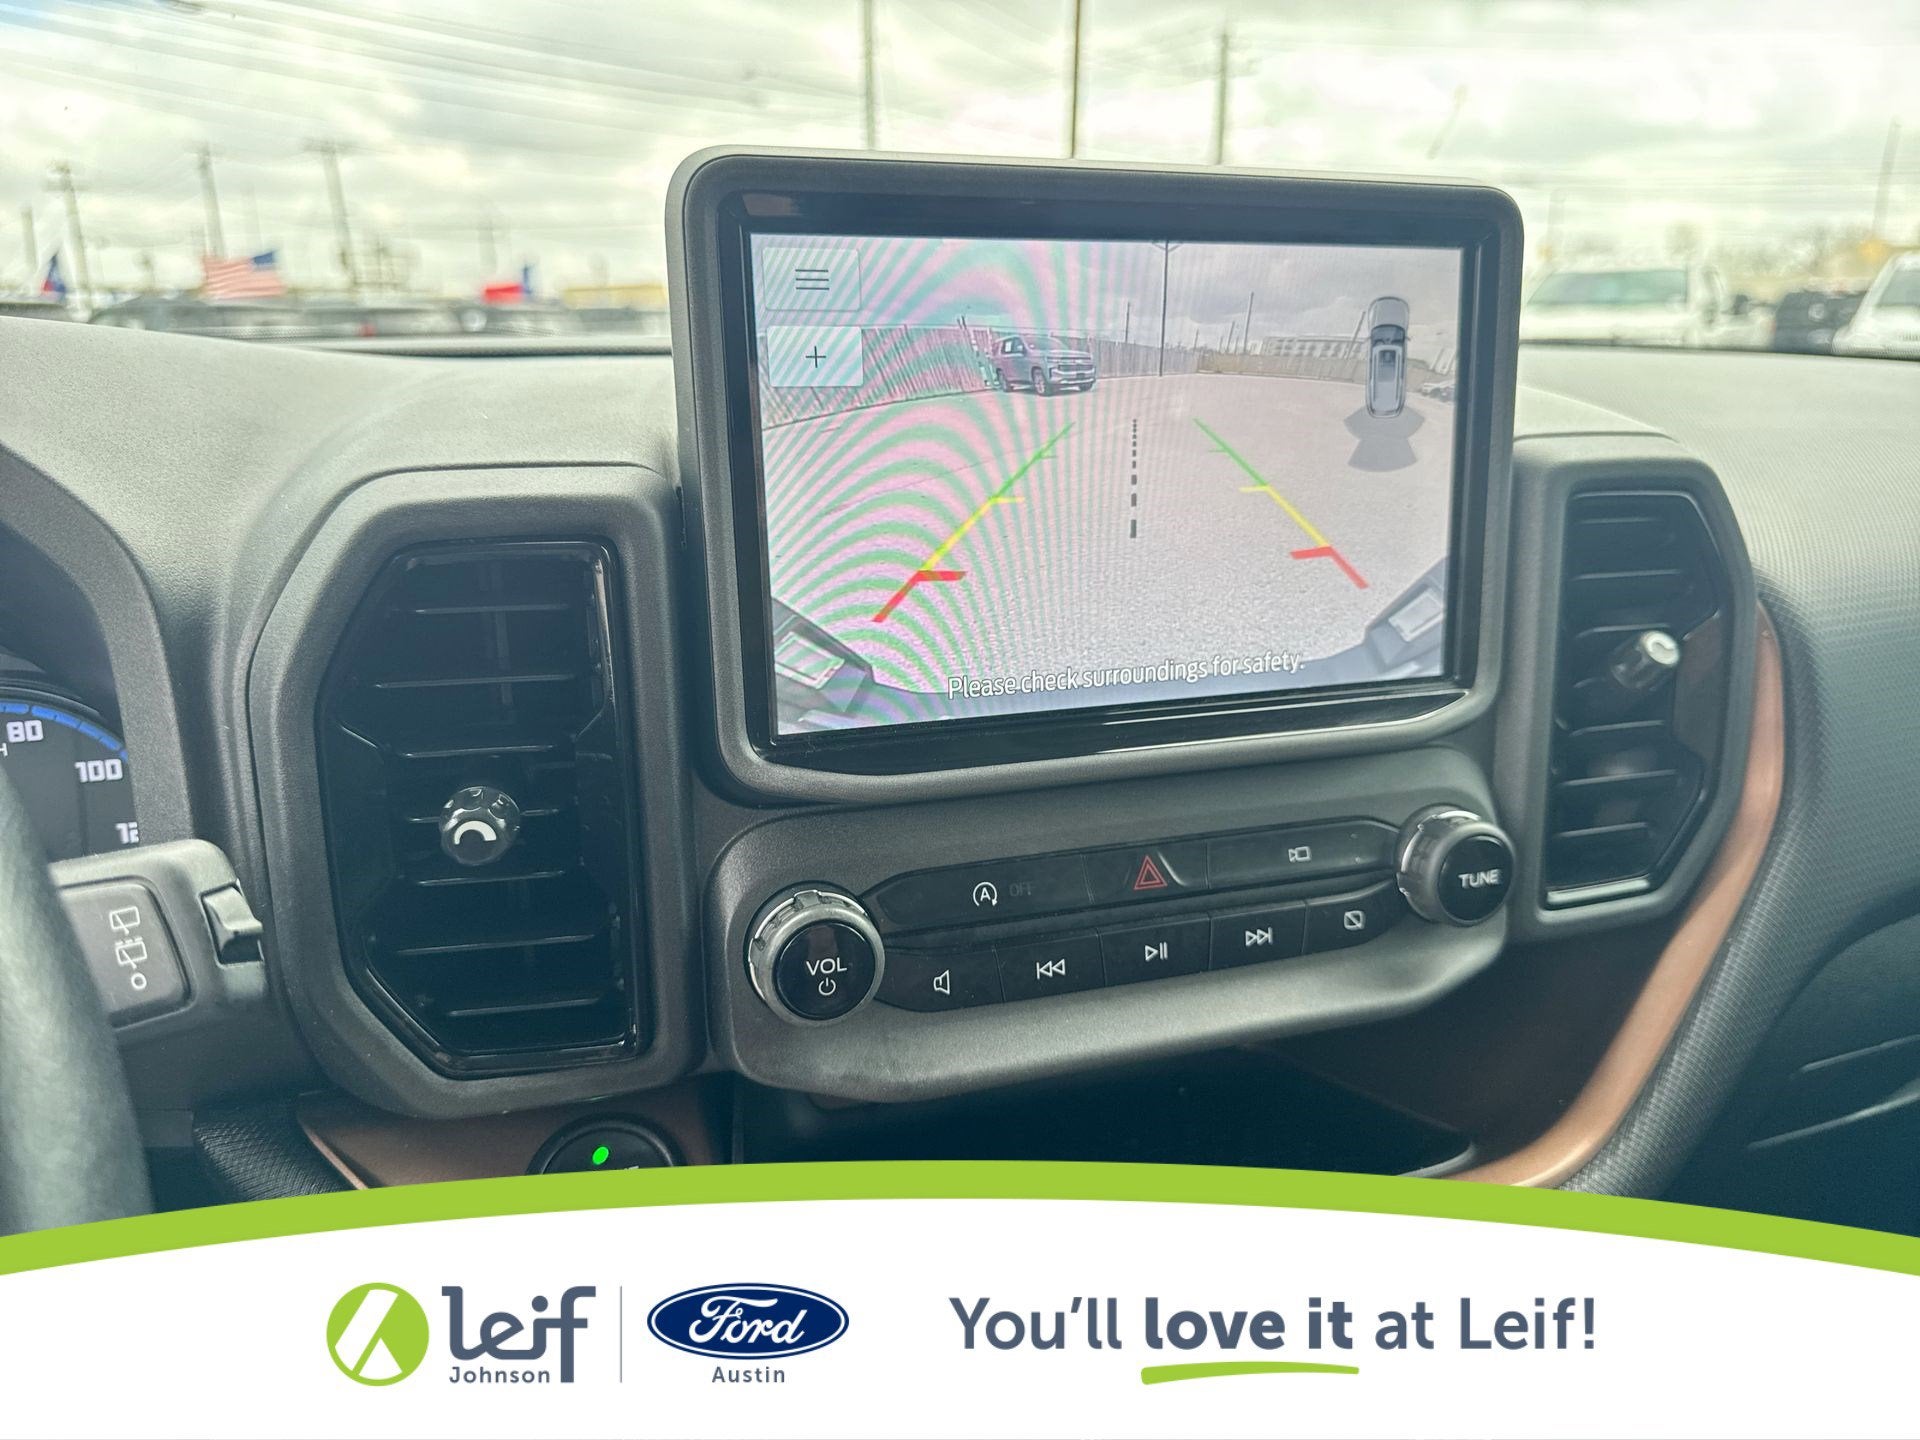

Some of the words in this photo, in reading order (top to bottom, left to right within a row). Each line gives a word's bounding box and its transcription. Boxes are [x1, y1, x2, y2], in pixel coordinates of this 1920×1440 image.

[948, 675, 1016, 700] Please
[1020, 667, 1079, 694] check
[1081, 657, 1208, 689] surroundings
[1211, 654, 1241, 676] for
[1242, 650, 1304, 675] safety.
[6, 720, 44, 743] 80
[74, 758, 123, 783] 100
[1458, 868, 1501, 889] TUNE
[806, 957, 848, 976] VOL
